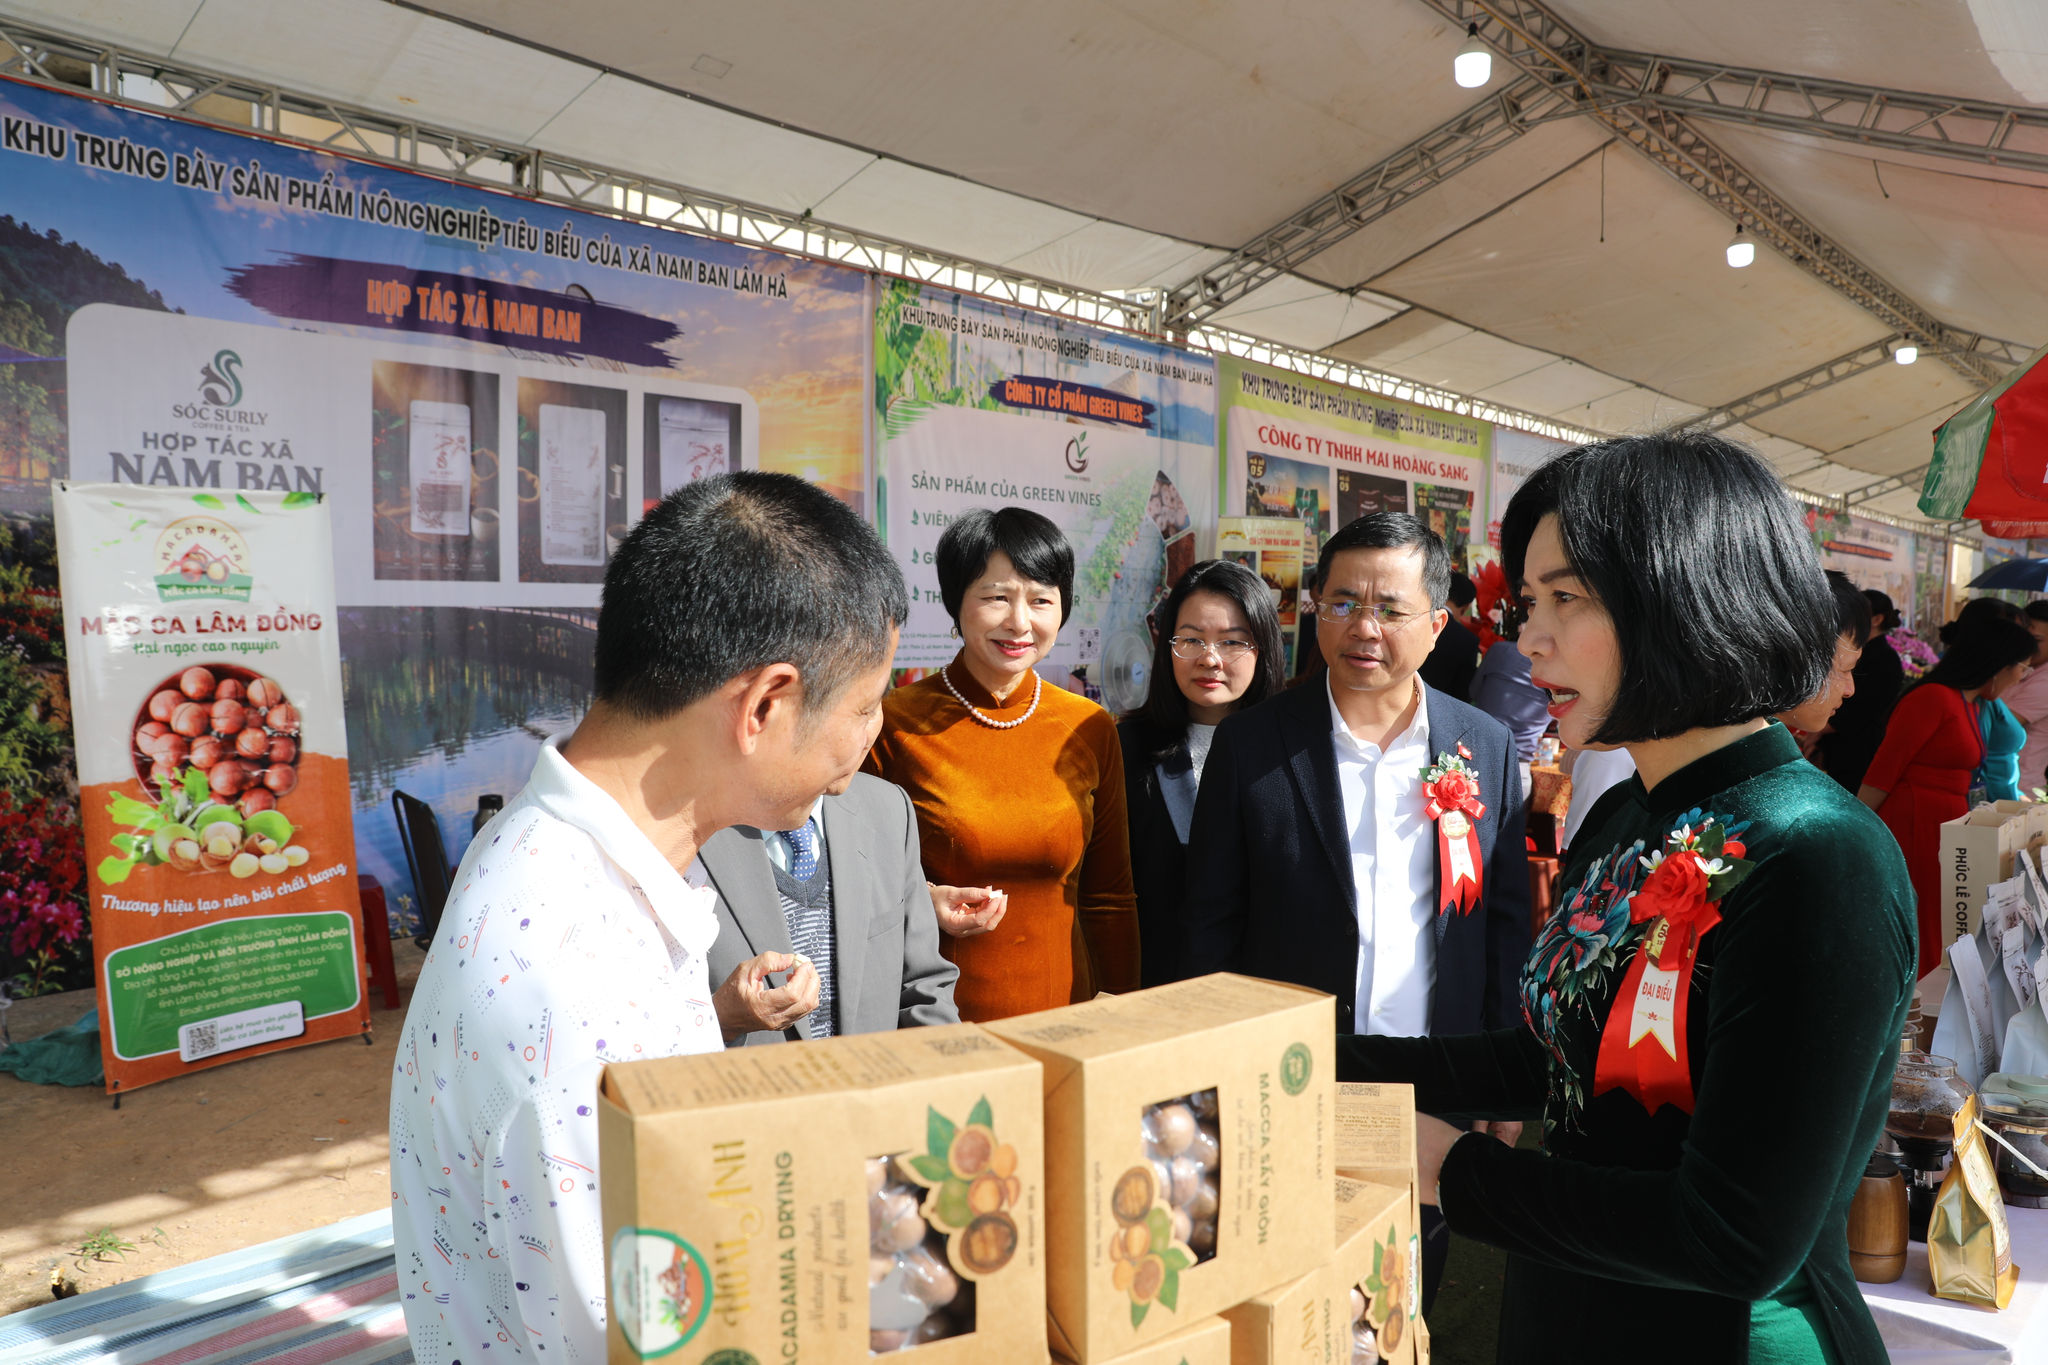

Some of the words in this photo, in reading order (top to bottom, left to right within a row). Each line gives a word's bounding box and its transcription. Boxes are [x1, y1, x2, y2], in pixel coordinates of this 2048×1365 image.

[3, 116, 66, 159] KHU
[74, 132, 167, 179] TRƯNG
[174, 151, 225, 191] BÀY
[232, 160, 280, 202] SẢN
[287, 171, 353, 217] PHẨM
[501, 219, 538, 251] TIÊU
[544, 222, 580, 260] BIỂU
[586, 233, 622, 268] CỦA
[628, 246, 651, 274] XÃ
[656, 254, 692, 282] NAM
[698, 262, 729, 288] BAN
[733, 266, 763, 293] LÂM
[768, 273, 788, 299] HÀ
[366, 278, 412, 324] HỢP
[416, 281, 458, 325] TÁC
[461, 290, 489, 329] XÃ
[493, 298, 539, 337] NAM
[542, 307, 581, 344] BAN
[902, 305, 924, 324] KHU
[926, 311, 959, 332] TRƯNG
[961, 316, 980, 336] BÀY
[981, 319, 1000, 340] SẢN
[1154, 362, 1170, 377] NAM
[1172, 366, 1187, 381] BAN
[172, 402, 210, 421] SÓC
[214, 408, 269, 426] SURLY
[1005, 378, 1033, 405] CÔNG
[1034, 385, 1046, 407] TY
[1089, 395, 1117, 419] GREEN
[1118, 401, 1143, 424] VINES
[191, 421, 225, 431] COFFEE
[235, 425, 250, 433] TEA
[142, 431, 197, 456] HỢP
[205, 434, 253, 457] TÁC
[260, 438, 294, 460] XÃ
[1257, 424, 1302, 451] CÔNG
[1305, 436, 1322, 455] TY
[1325, 440, 1362, 464] TNHH
[1366, 448, 1390, 469] MAI
[1392, 455, 1436, 477] HOÀNG
[1439, 463, 1469, 482] SANG
[108, 451, 222, 489] NAM
[235, 461, 324, 494] BAN
[911, 470, 941, 491] SẢN
[991, 478, 1019, 499] CỦA
[1022, 486, 1065, 503] GREEN
[1068, 491, 1102, 508] VINES
[160, 525, 243, 561] MACADAMIA
[150, 615, 187, 635] CA
[195, 610, 248, 634] LÂM
[256, 604, 322, 633] ĐỒNG
[163, 641, 197, 657] ngọc
[202, 642, 227, 653] cao
[231, 637, 281, 655] nguyên
[1955, 847, 1970, 882] PHÚC
[101, 894, 162, 917] Thương
[163, 899, 195, 917] hiệu
[197, 898, 221, 915] tạo
[223, 894, 250, 909] nên
[251, 886, 276, 903] bởi
[276, 876, 308, 896] chất
[307, 863, 348, 886] lượng
[1955, 885, 1971, 898] LÊ
[1641, 981, 1656, 1000] ĐẠI
[1655, 979, 1673, 1002] BIỂU
[539, 1007, 549, 1043] NISHA
[1259, 1072, 1271, 1149] MACCA
[1259, 1152, 1275, 1187] SẤY
[775, 1151, 796, 1240] DRYING
[1257, 1194, 1271, 1246] GIÒN
[434, 1229, 454, 1254] NISHA
[519, 1234, 549, 1251] NISHA
